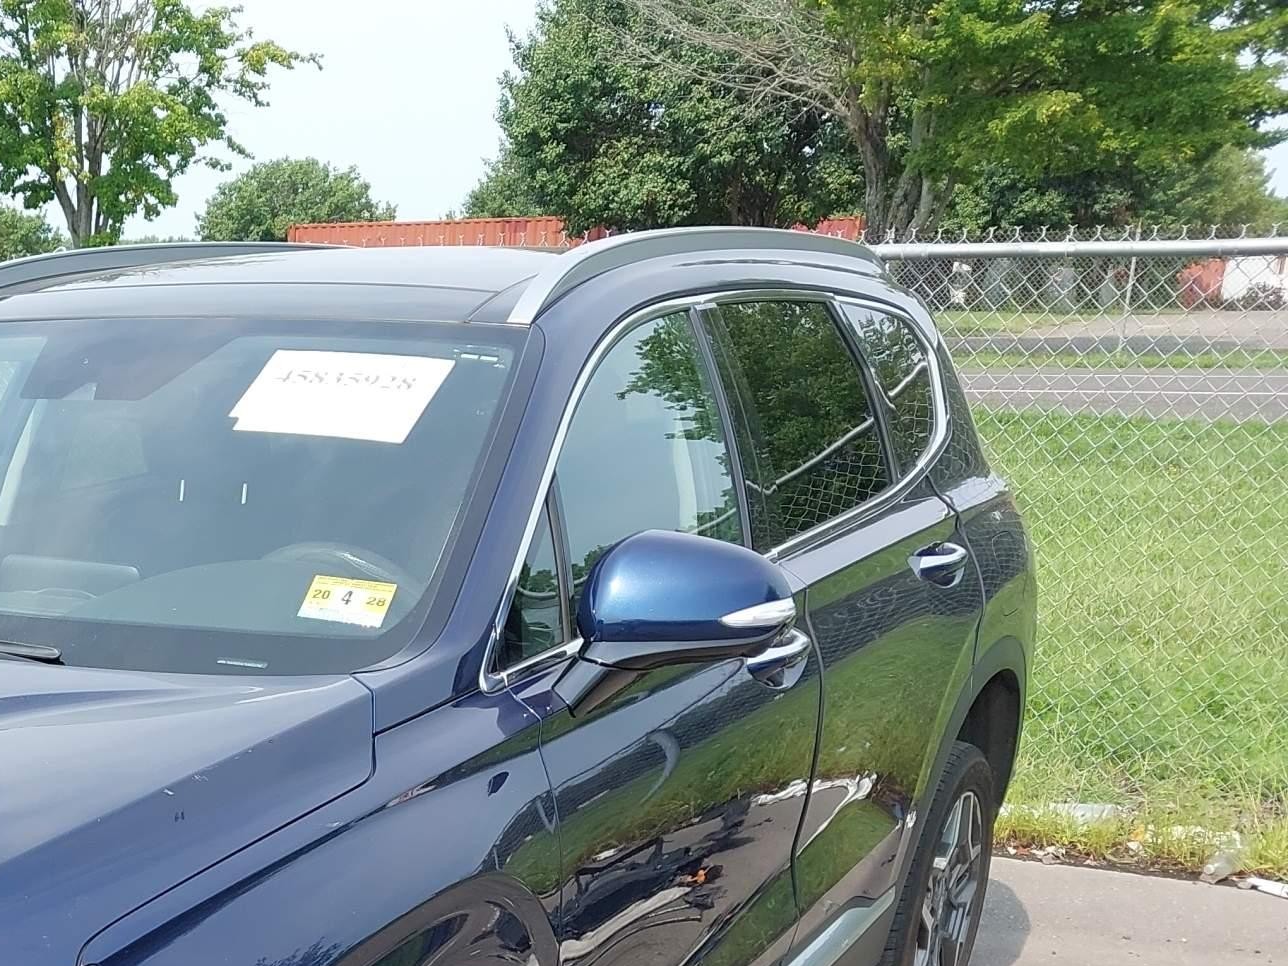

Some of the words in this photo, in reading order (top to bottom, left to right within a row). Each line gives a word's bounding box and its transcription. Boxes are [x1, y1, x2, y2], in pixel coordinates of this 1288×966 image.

[312, 589, 331, 600] 20
[341, 590, 353, 605] 4
[366, 597, 387, 607] 28
